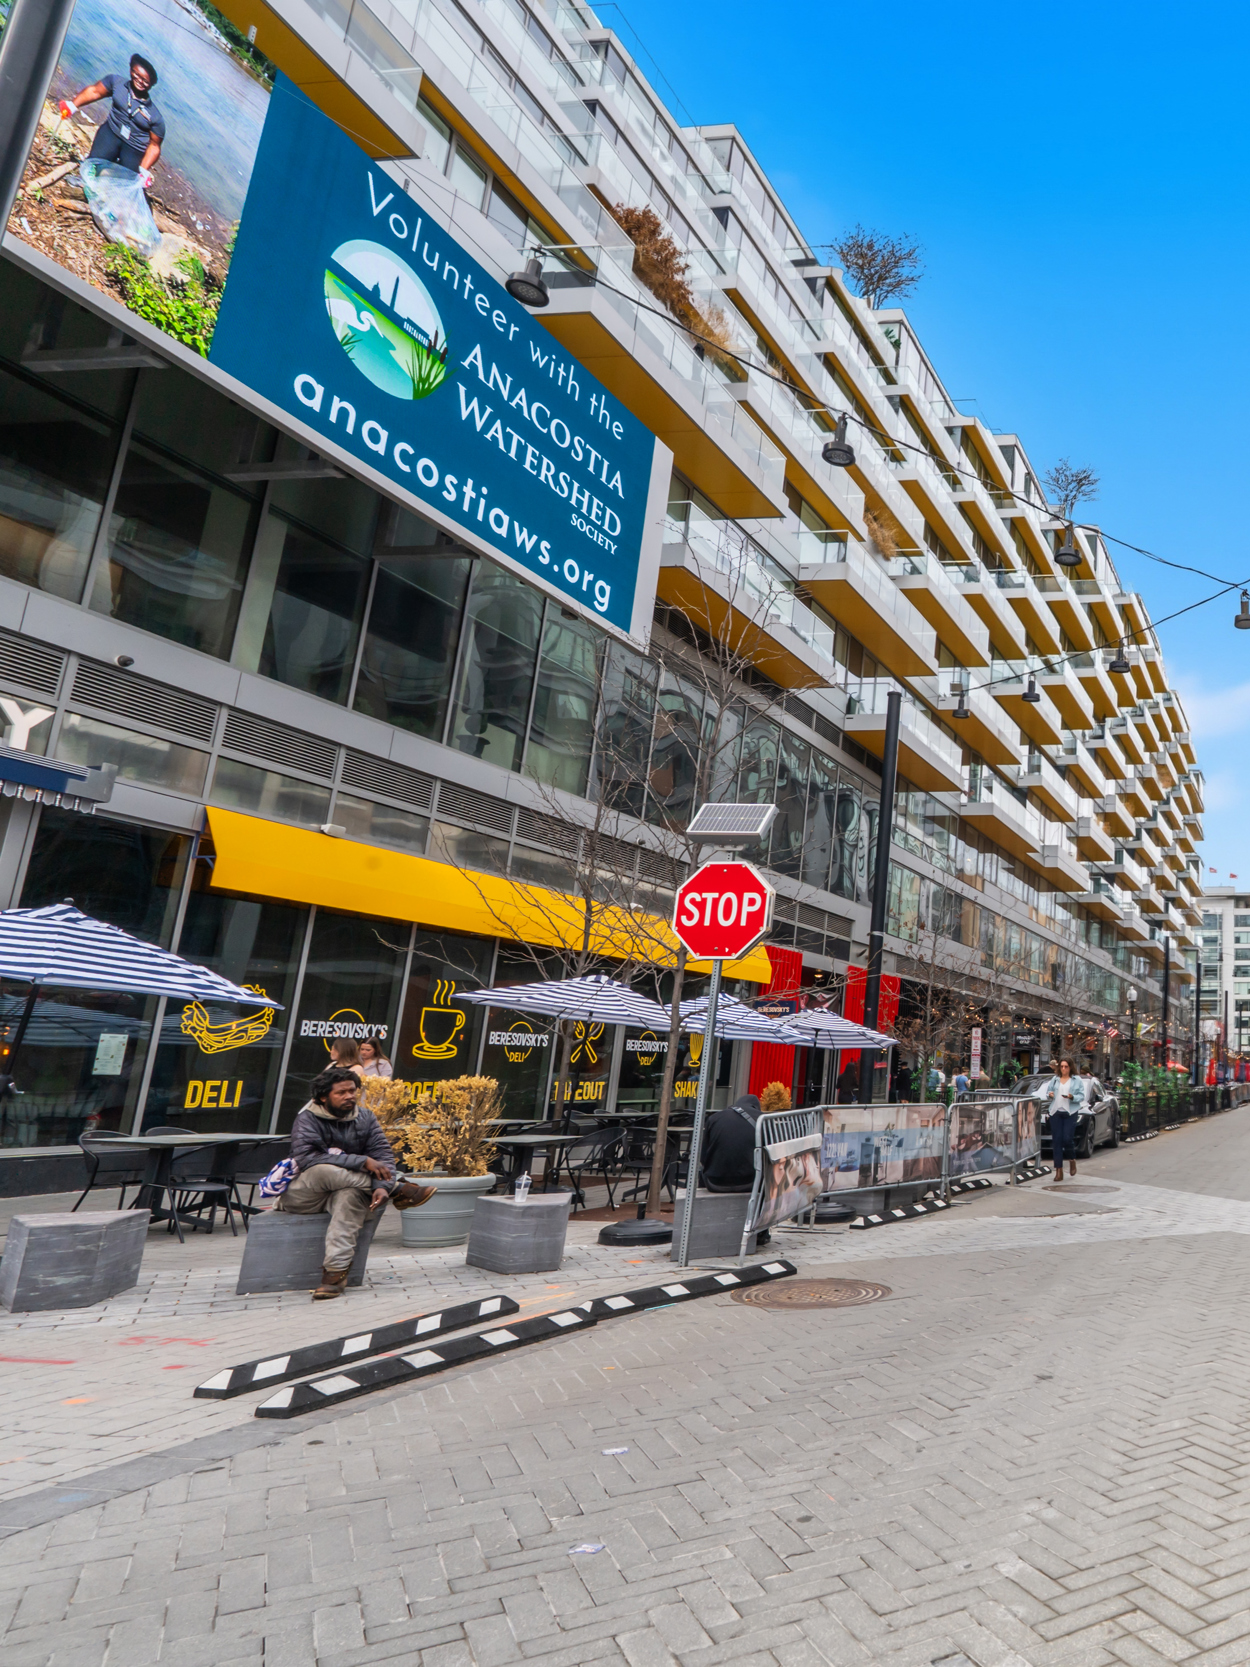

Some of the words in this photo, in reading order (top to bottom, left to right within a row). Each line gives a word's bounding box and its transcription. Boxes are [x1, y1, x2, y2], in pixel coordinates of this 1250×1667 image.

[367, 171, 520, 342] Volunteer
[529, 340, 580, 402] with
[589, 393, 625, 441] the
[460, 343, 626, 500] ANACOSTIA
[456, 381, 623, 538] WATERSHED
[293, 373, 612, 613] anacostiaws.org
[570, 512, 619, 555] SOCIETY
[680, 891, 762, 927] STOP
[300, 1019, 389, 1040] BERESOVSKY'S
[488, 1031, 549, 1047] BERESOVSKY'S
[508, 1052, 525, 1063] DELI
[625, 1039, 669, 1053] BERESOVSKY'S
[640, 1056, 652, 1065] DELI
[184, 1080, 243, 1109] DELI
[674, 1081, 699, 1098] SHAK
